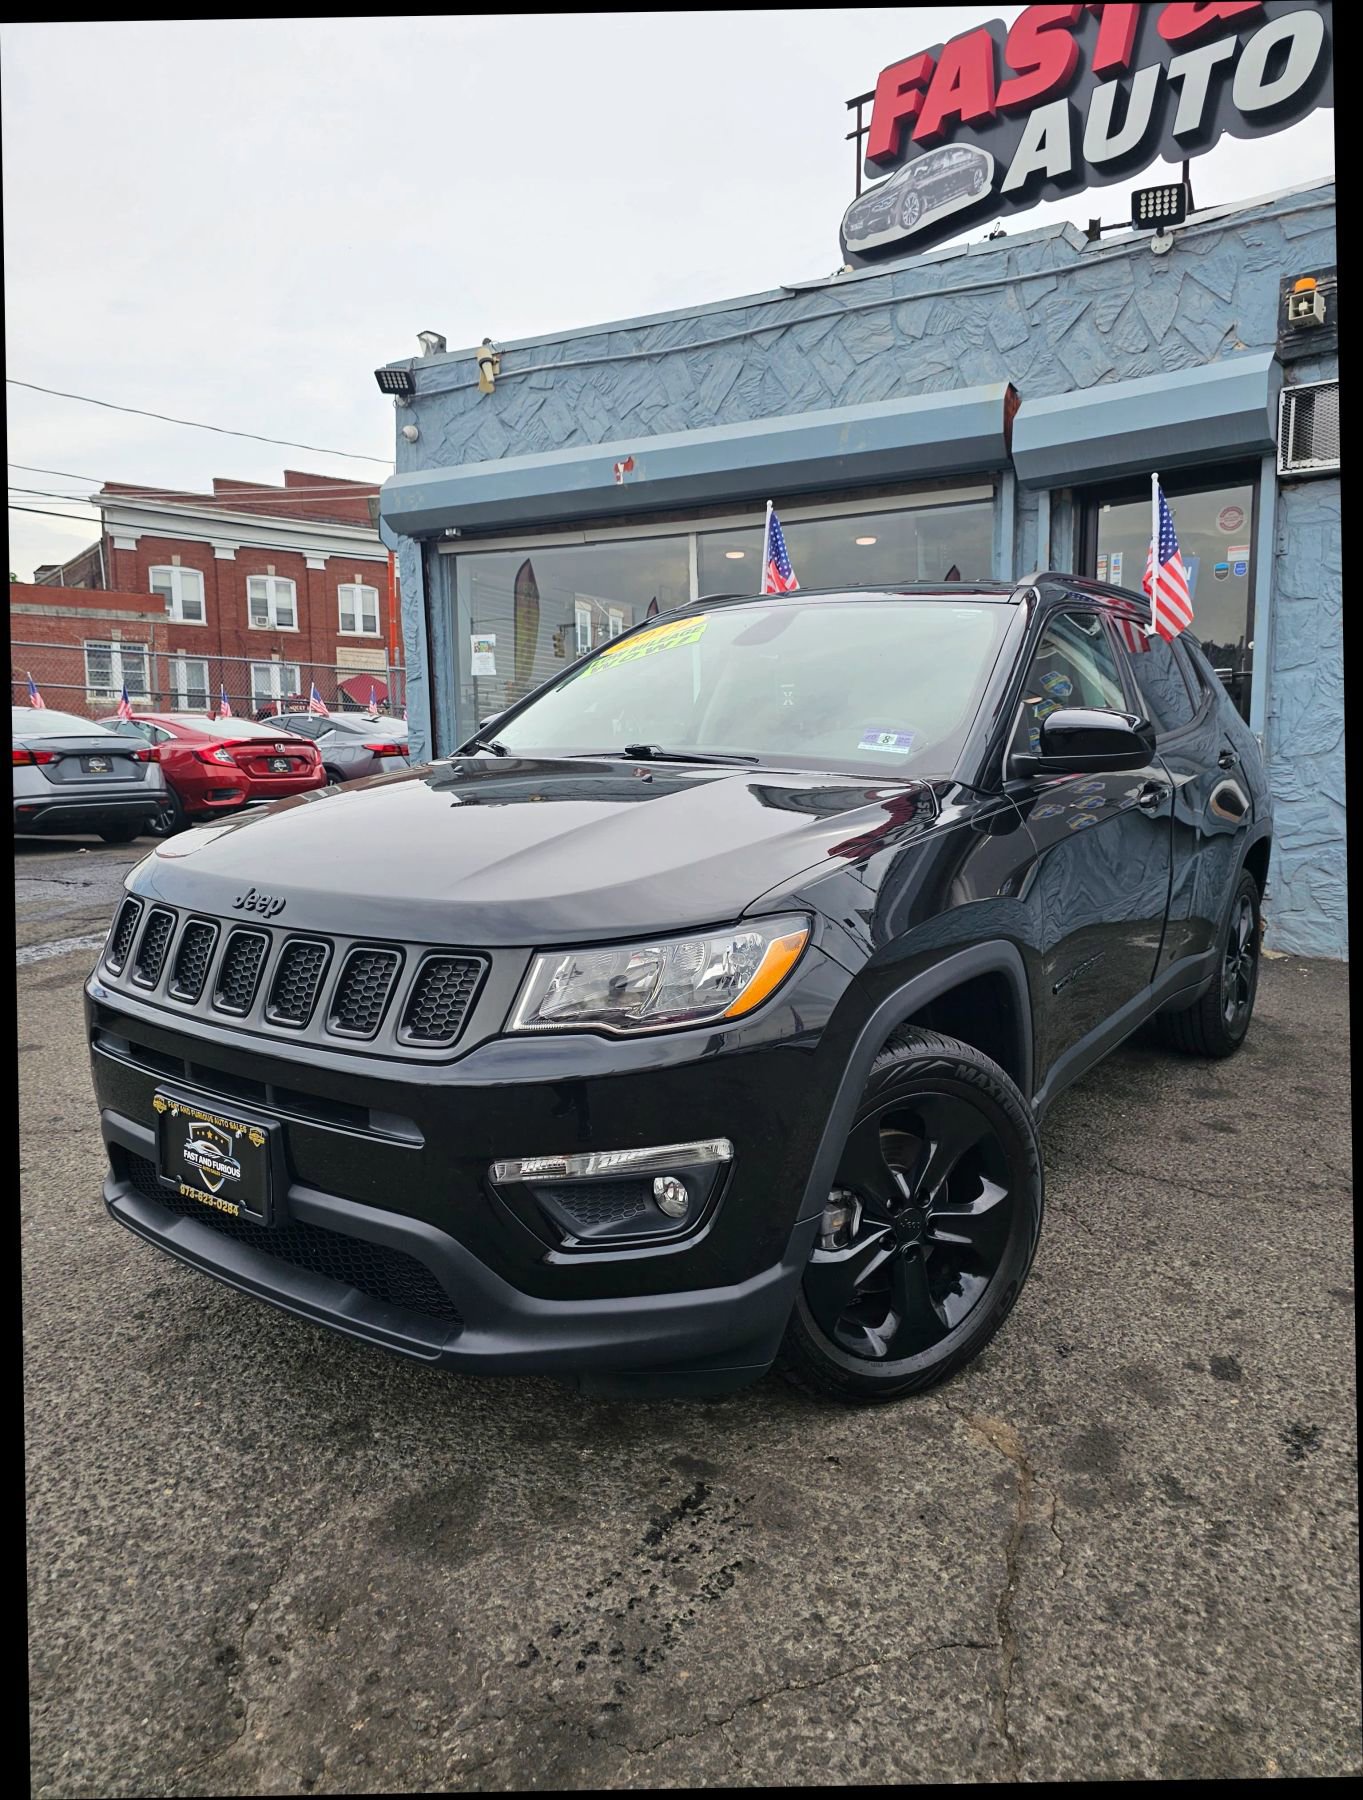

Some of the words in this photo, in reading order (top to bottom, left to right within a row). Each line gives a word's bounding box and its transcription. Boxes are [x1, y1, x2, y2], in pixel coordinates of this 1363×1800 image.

[867, 4, 1128, 161] FAST
[1001, 10, 1324, 193] AUTO
[882, 735, 891, 744] 8
[232, 887, 286, 919] Jeep
[180, 1106, 190, 1115] AND
[184, 1149, 199, 1162] FAST
[199, 1155, 212, 1167] AND
[212, 1160, 241, 1178] FURIOUS
